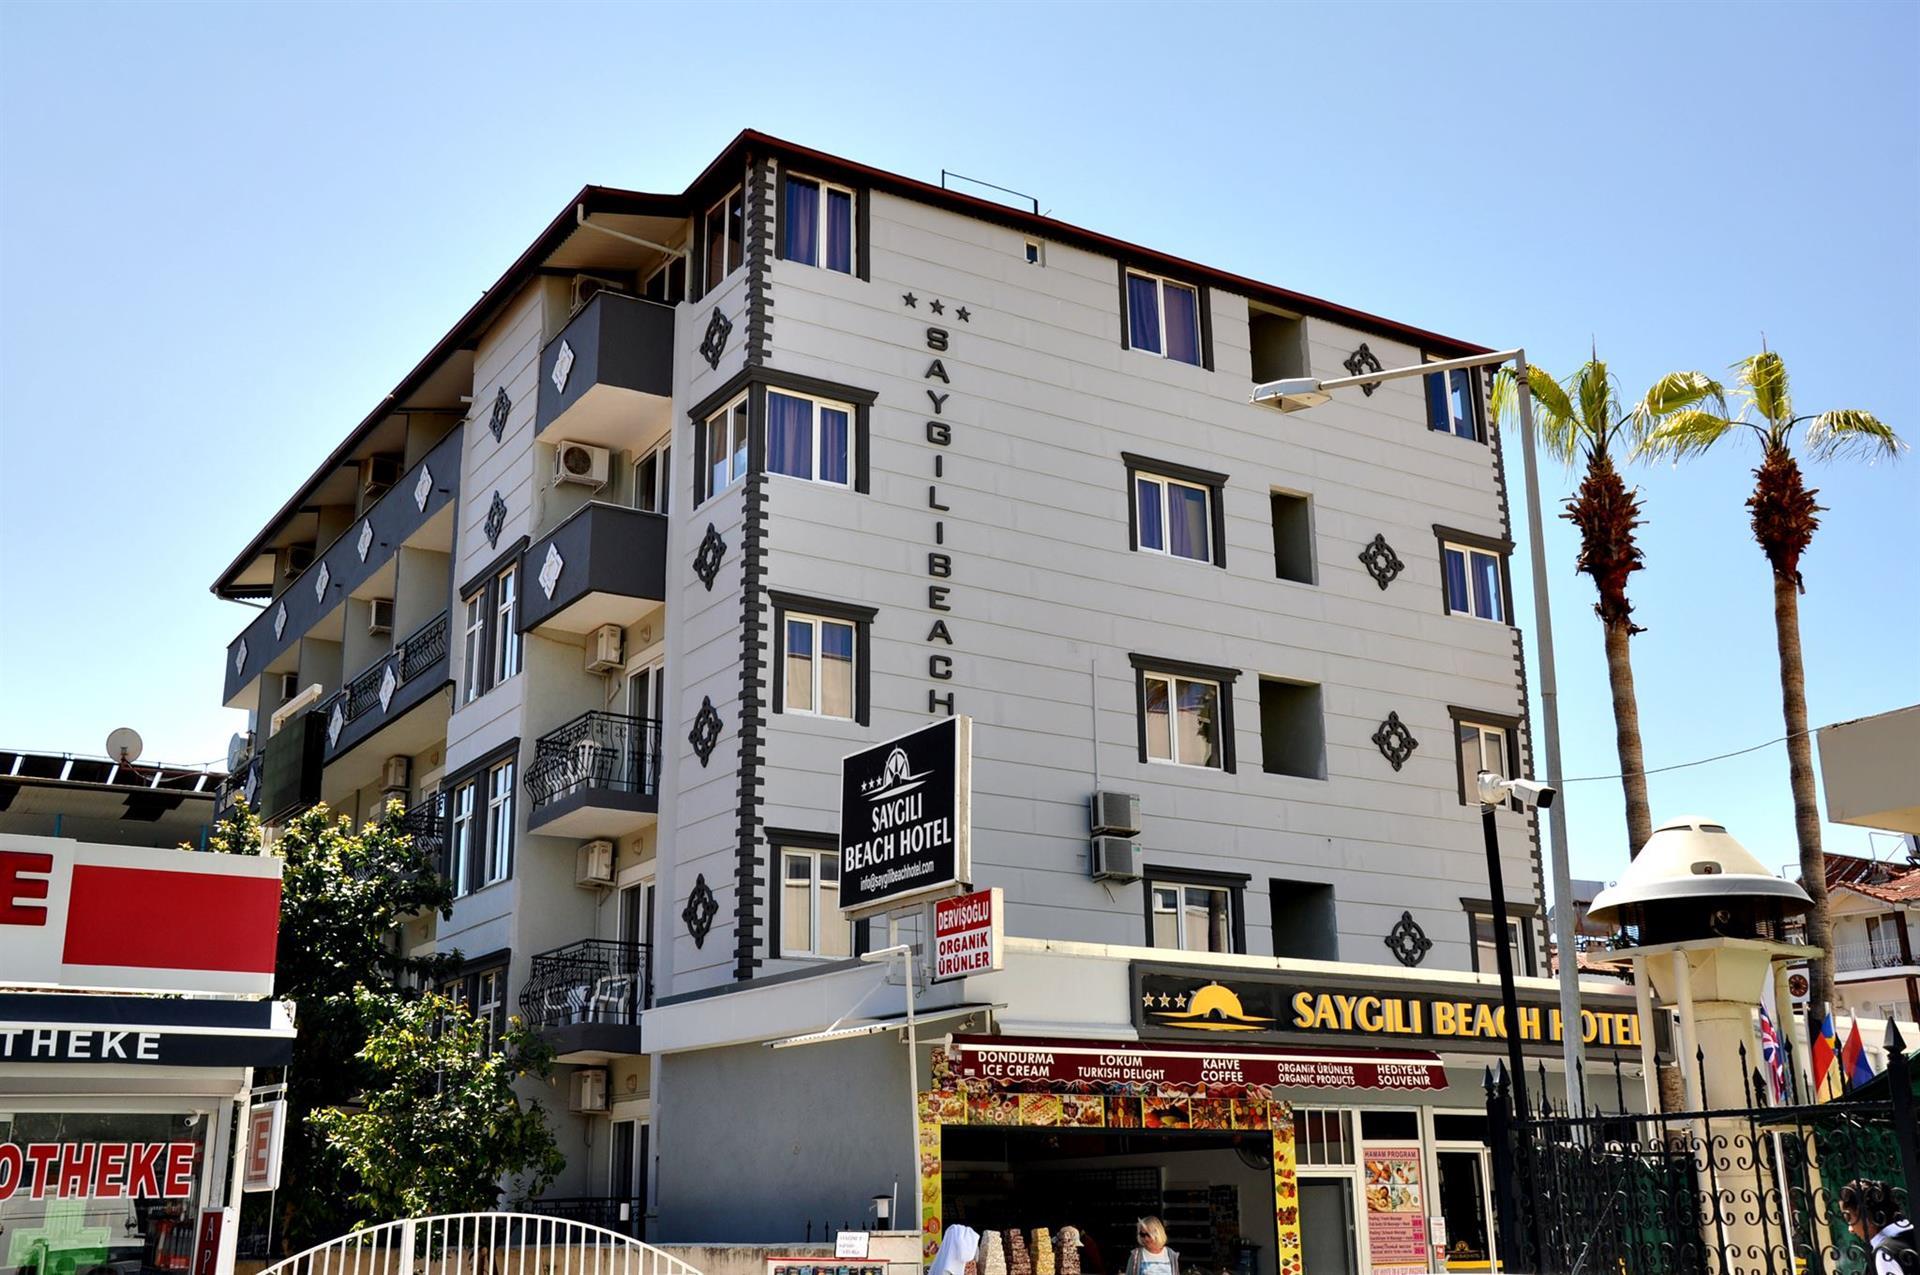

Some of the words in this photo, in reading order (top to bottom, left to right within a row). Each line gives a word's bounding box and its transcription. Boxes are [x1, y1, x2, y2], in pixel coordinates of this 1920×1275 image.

[872, 793, 922, 833] SAYGILI
[845, 833, 895, 873] BEACH
[900, 817, 952, 857] HOTEL
[938, 951, 990, 976] ÜRÜNLER
[1292, 991, 1422, 1034] SAYGILI
[977, 1050, 1055, 1065] DONDURMA
[1099, 1055, 1143, 1067] LOKUM
[982, 1065, 1003, 1076] ICE
[1006, 1065, 1050, 1077] CREAM
[1202, 1058, 1240, 1071] KAHVE
[1317, 1062, 1354, 1075] ÜRÜNLER
[1078, 1066, 1120, 1079] TURKISH
[1123, 1067, 1165, 1081] DELIGHT
[1200, 1070, 1244, 1083] COFFEE
[1278, 1073, 1315, 1084] ORGANIC
[1316, 1074, 1356, 1086] PRODUCTS
[1377, 1075, 1431, 1086] SOUVENIR
[1387, 1150, 1417, 1158] PROGRAM
